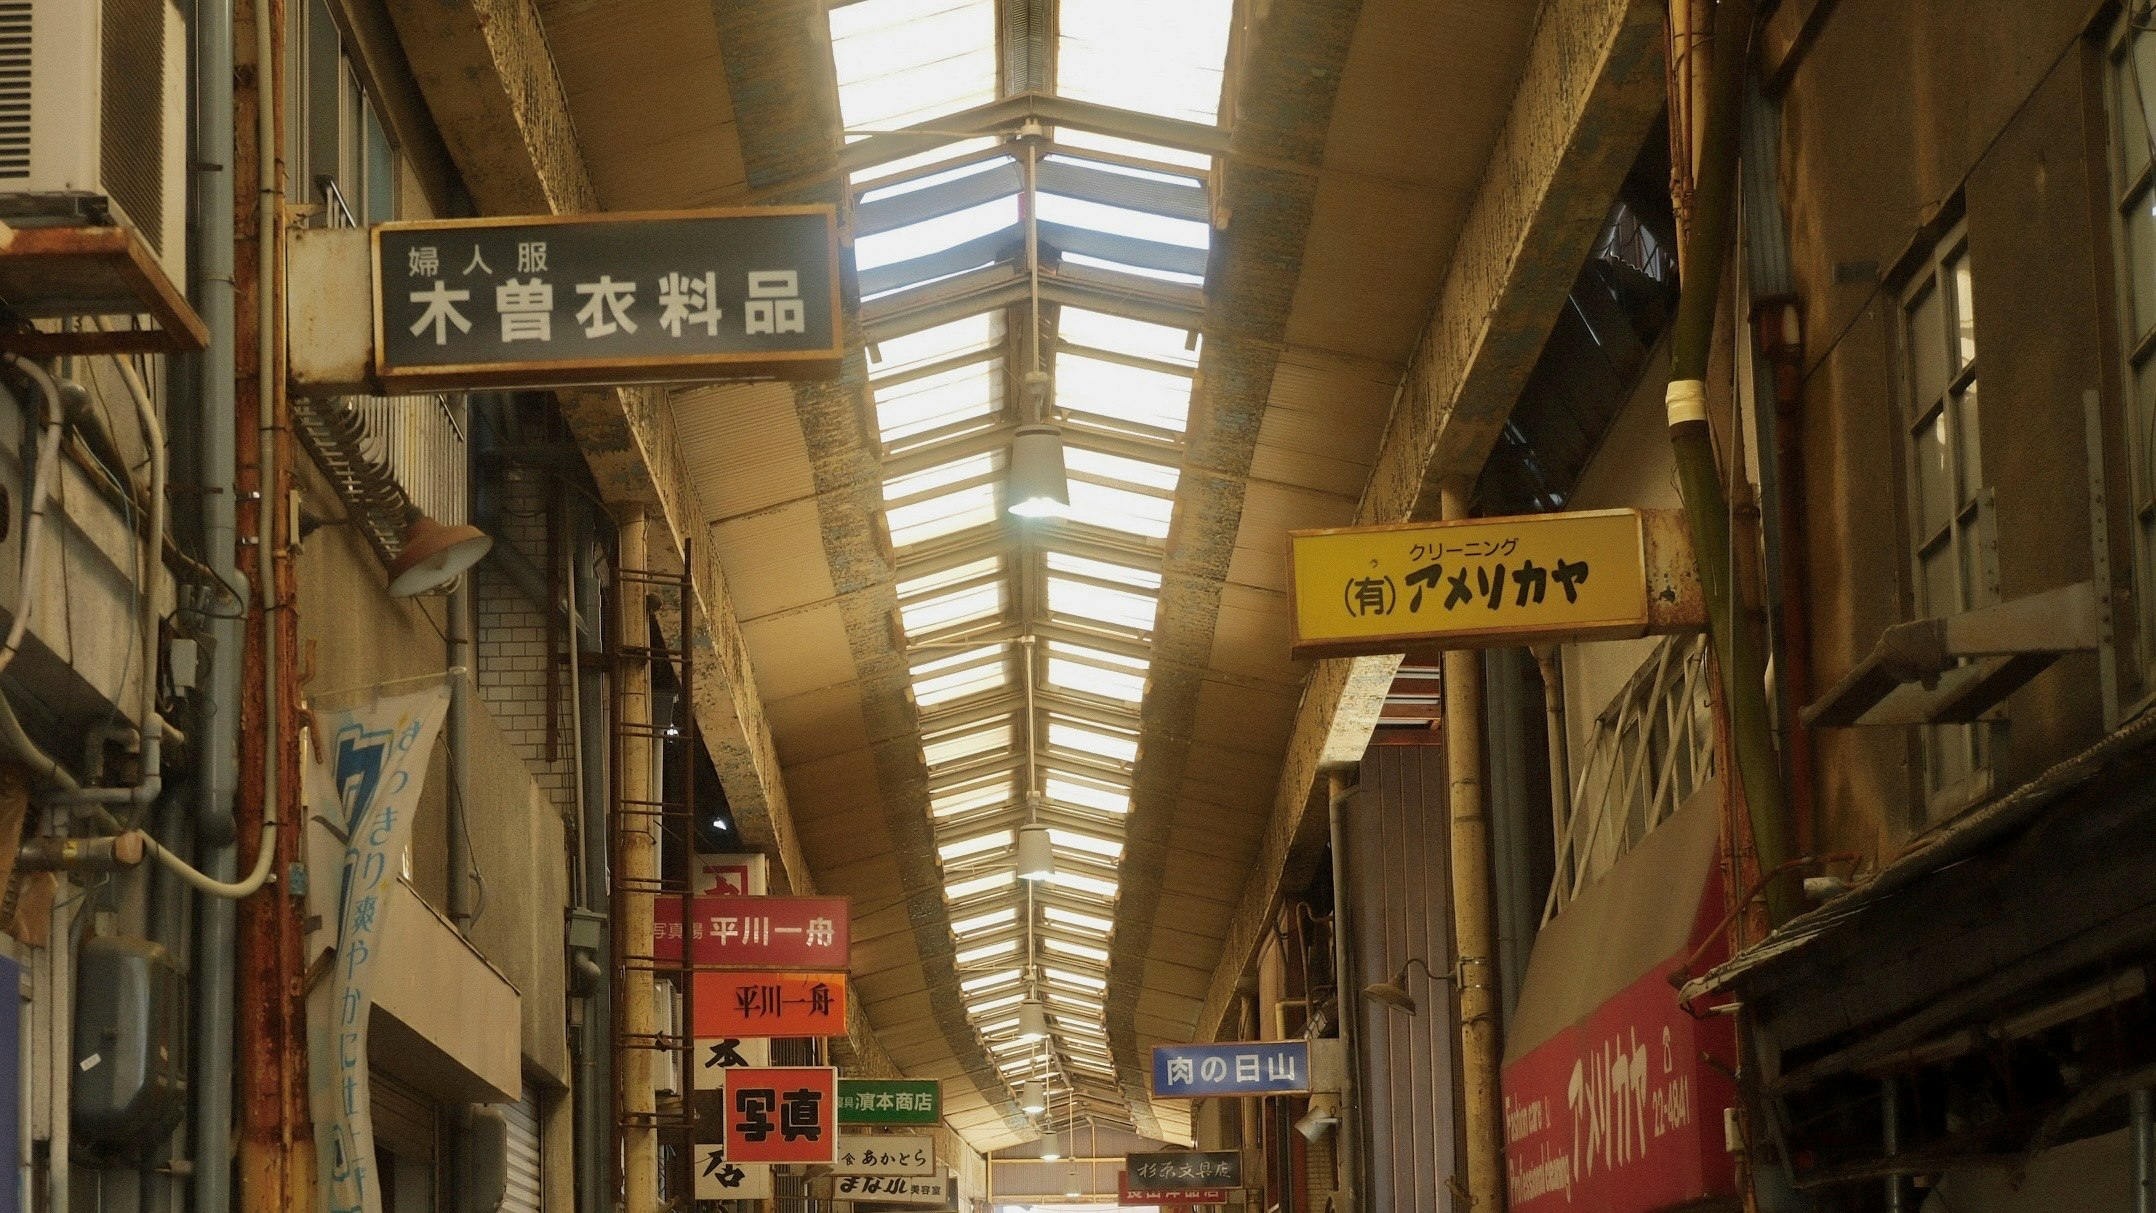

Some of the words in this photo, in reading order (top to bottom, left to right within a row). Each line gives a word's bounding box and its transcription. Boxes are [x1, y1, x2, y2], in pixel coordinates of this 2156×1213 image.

[408, 242, 548, 278] 婦人服
[409, 269, 805, 345] 木曽衣料品
[1409, 538, 1519, 562] クリーニング
[709, 916, 835, 947] 平川一舟
[734, 983, 835, 1018] 平川一舟
[1166, 1052, 1295, 1086] 肉の日山
[735, 1088, 823, 1143] 写真
[861, 1148, 927, 1167] あかとら
